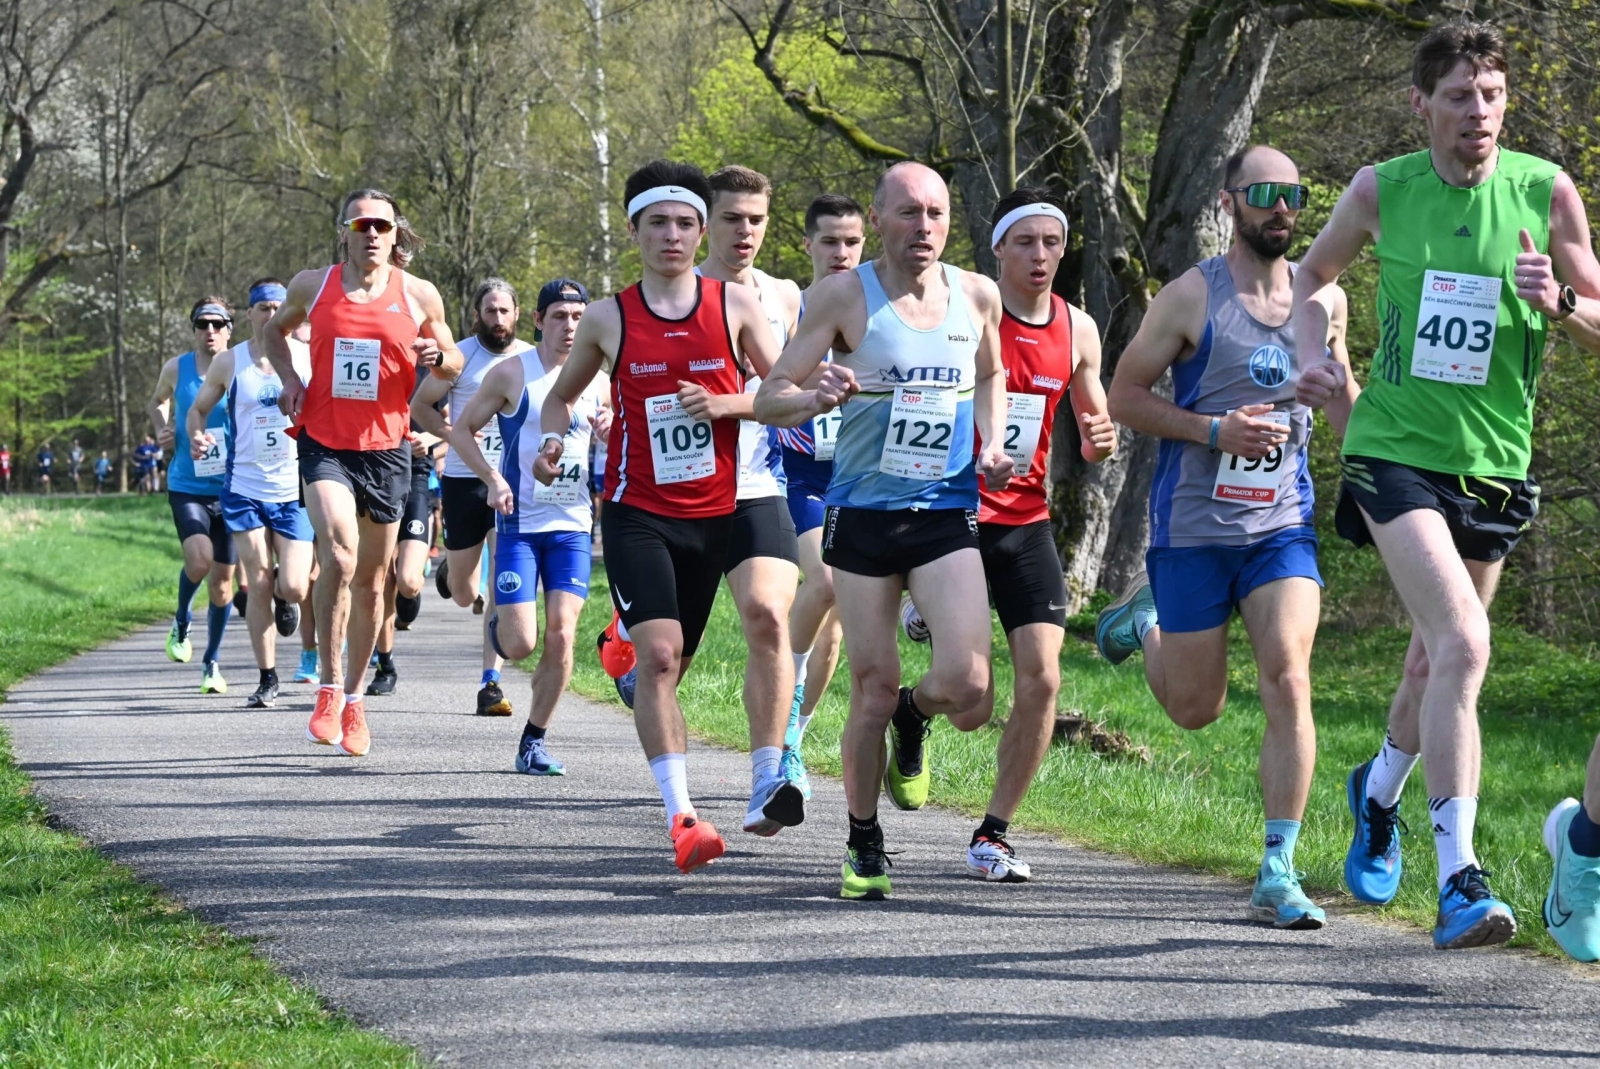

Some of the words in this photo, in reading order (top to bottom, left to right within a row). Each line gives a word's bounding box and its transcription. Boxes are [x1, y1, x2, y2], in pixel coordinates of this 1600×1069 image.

[1433, 275, 1457, 283] PRIMATOR
[1432, 282, 1456, 292] CUP
[1436, 297, 1472, 307] BABIČČINÝM
[1473, 301, 1496, 310] ÚDOLÍM
[1417, 314, 1492, 353] 403
[630, 362, 668, 375] Krakonoš
[689, 358, 724, 368] MARATON
[343, 361, 371, 381] 16
[882, 364, 962, 383] ASTER
[901, 395, 921, 403] CUP
[653, 404, 673, 413] CUP
[905, 408, 934, 416] BABIČČINÝM
[660, 414, 689, 422] BABIČČINÝM
[817, 416, 843, 439] 17
[266, 431, 277, 447] 5
[652, 422, 711, 454] 109
[892, 419, 952, 451] 122
[683, 452, 703, 460] SOUČEK
[912, 451, 947, 459] VAGENKNECHT
[1223, 486, 1253, 497] PRIMATOR
